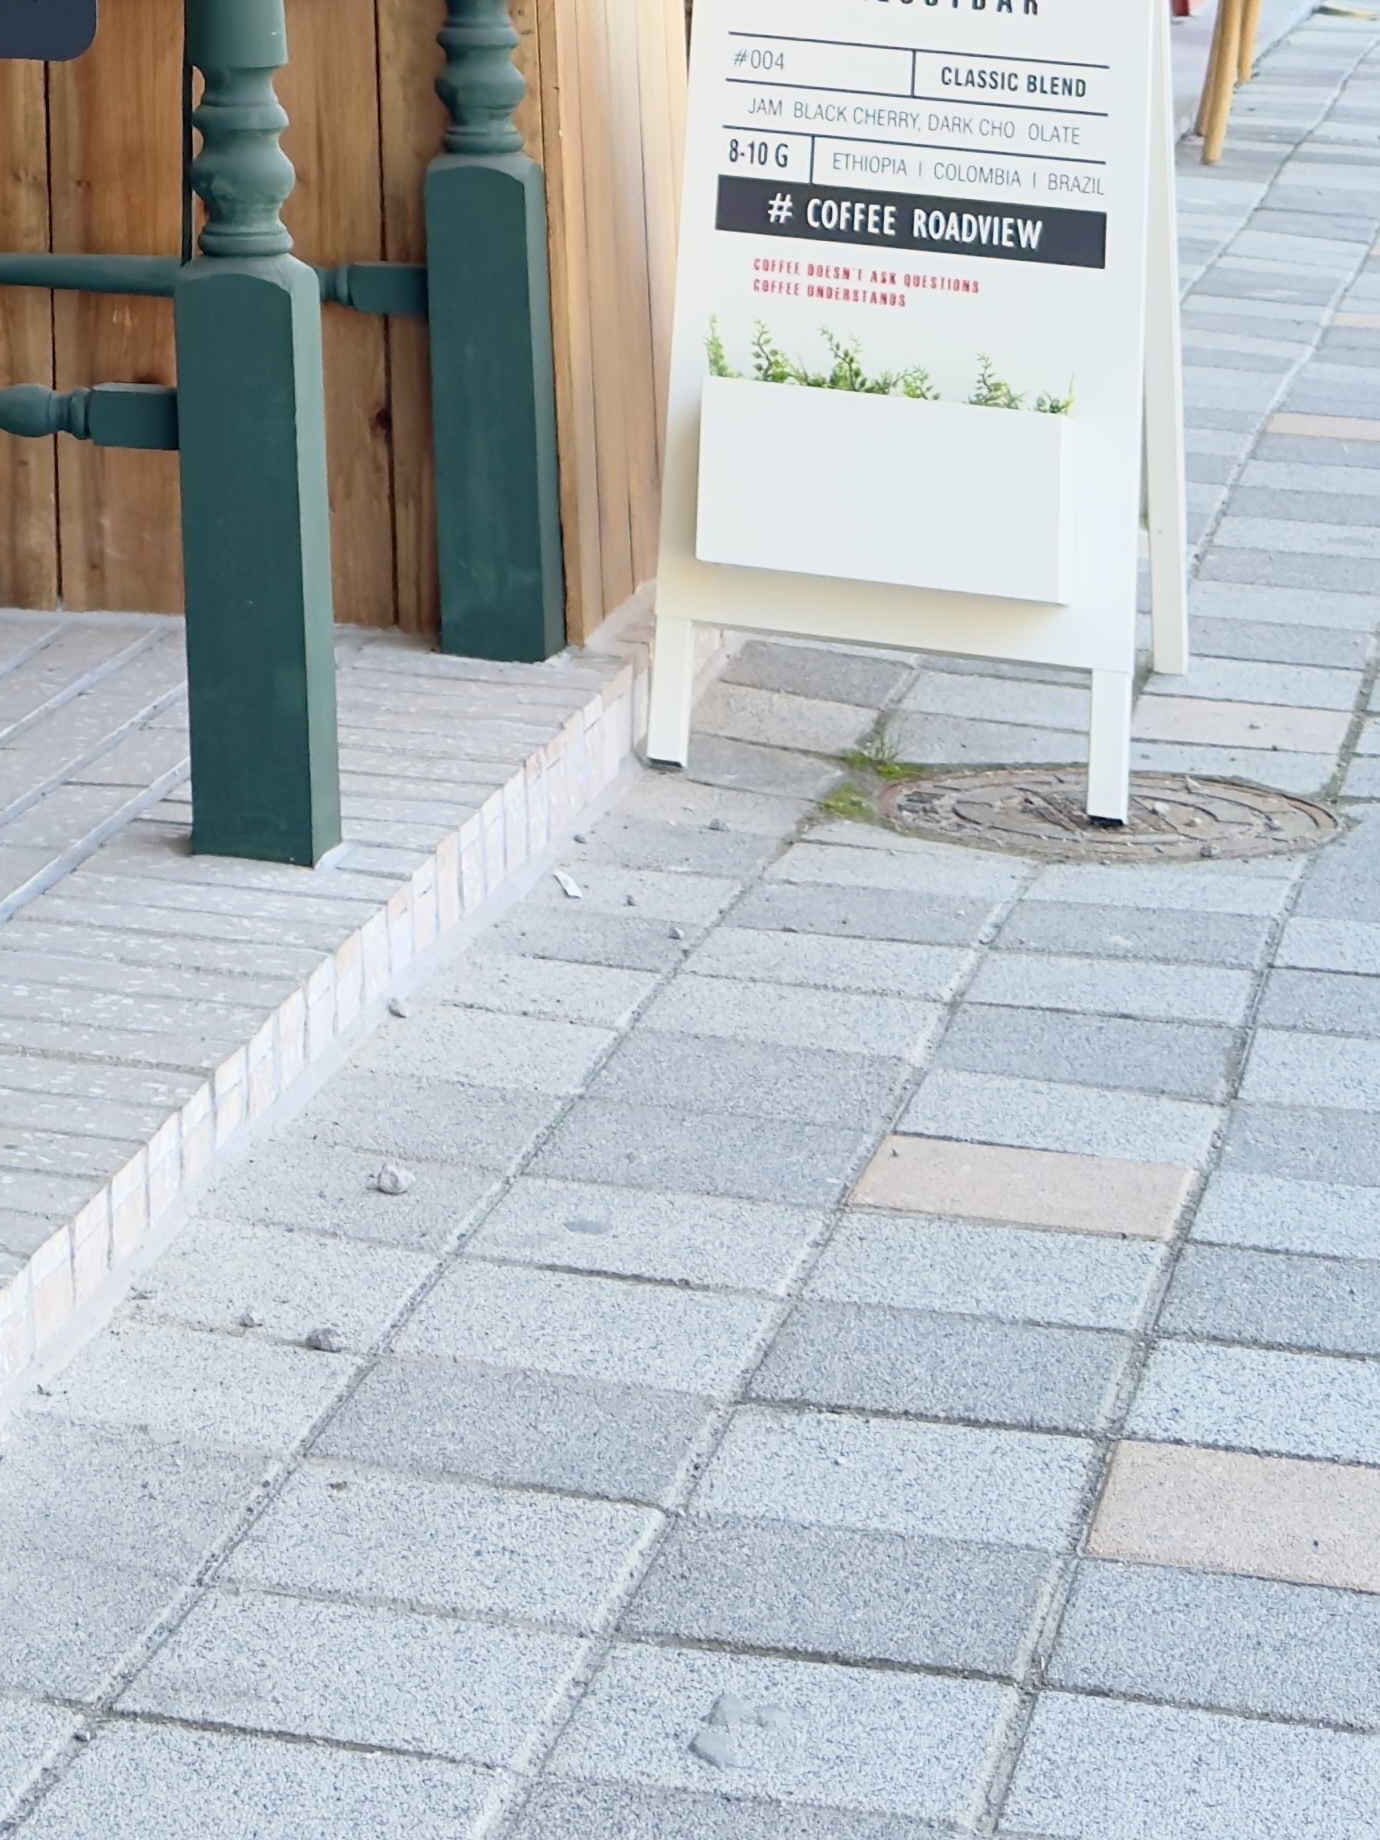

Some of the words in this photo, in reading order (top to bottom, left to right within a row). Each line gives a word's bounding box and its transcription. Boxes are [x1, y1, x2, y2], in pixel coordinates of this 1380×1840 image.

[732, 49, 785, 71] #004
[941, 66, 1019, 92] CLASSIC
[1026, 73, 1087, 99] BLEND
[748, 98, 783, 116] JAM
[793, 101, 847, 123] BLACK
[852, 106, 922, 131] CHERRY,
[928, 113, 972, 135] DARK
[728, 139, 768, 167] 8-10
[775, 143, 789, 169] G
[833, 152, 907, 177] ETHIOPIA
[934, 162, 1022, 188] COLOMBIA
[1048, 173, 1105, 196] BRAZIL
[806, 198, 897, 236] COFFEE
[913, 209, 1043, 250] ROADVIEW
[753, 258, 801, 276] COFFEE
[870, 271, 897, 285] ASK
[753, 279, 800, 296] COFFEE
[807, 284, 906, 307] UNDERSTANDS
